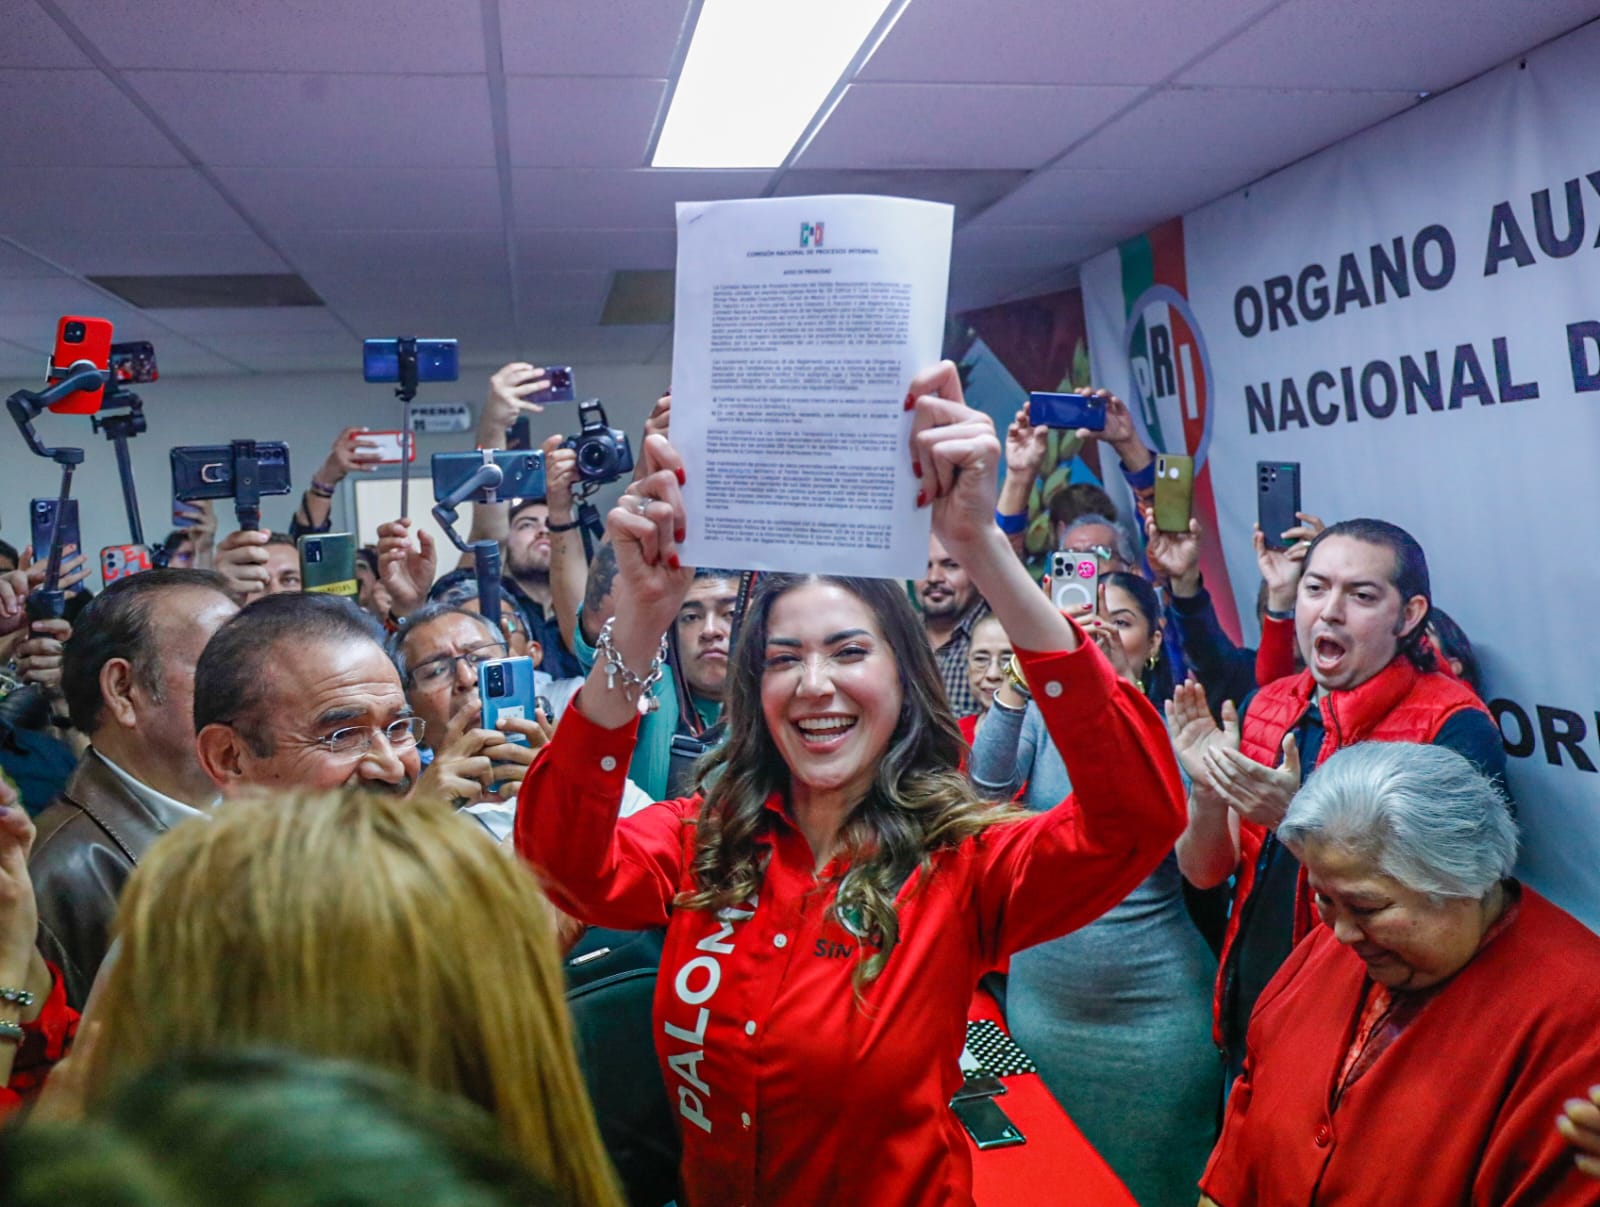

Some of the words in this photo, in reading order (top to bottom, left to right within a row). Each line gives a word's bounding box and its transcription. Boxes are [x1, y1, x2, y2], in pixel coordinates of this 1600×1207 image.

[1234, 224, 1456, 338] ORGANO
[1131, 324, 1199, 425] PRI
[1244, 336, 1540, 435] NACIONAL
[664, 893, 759, 1133] PALOM
